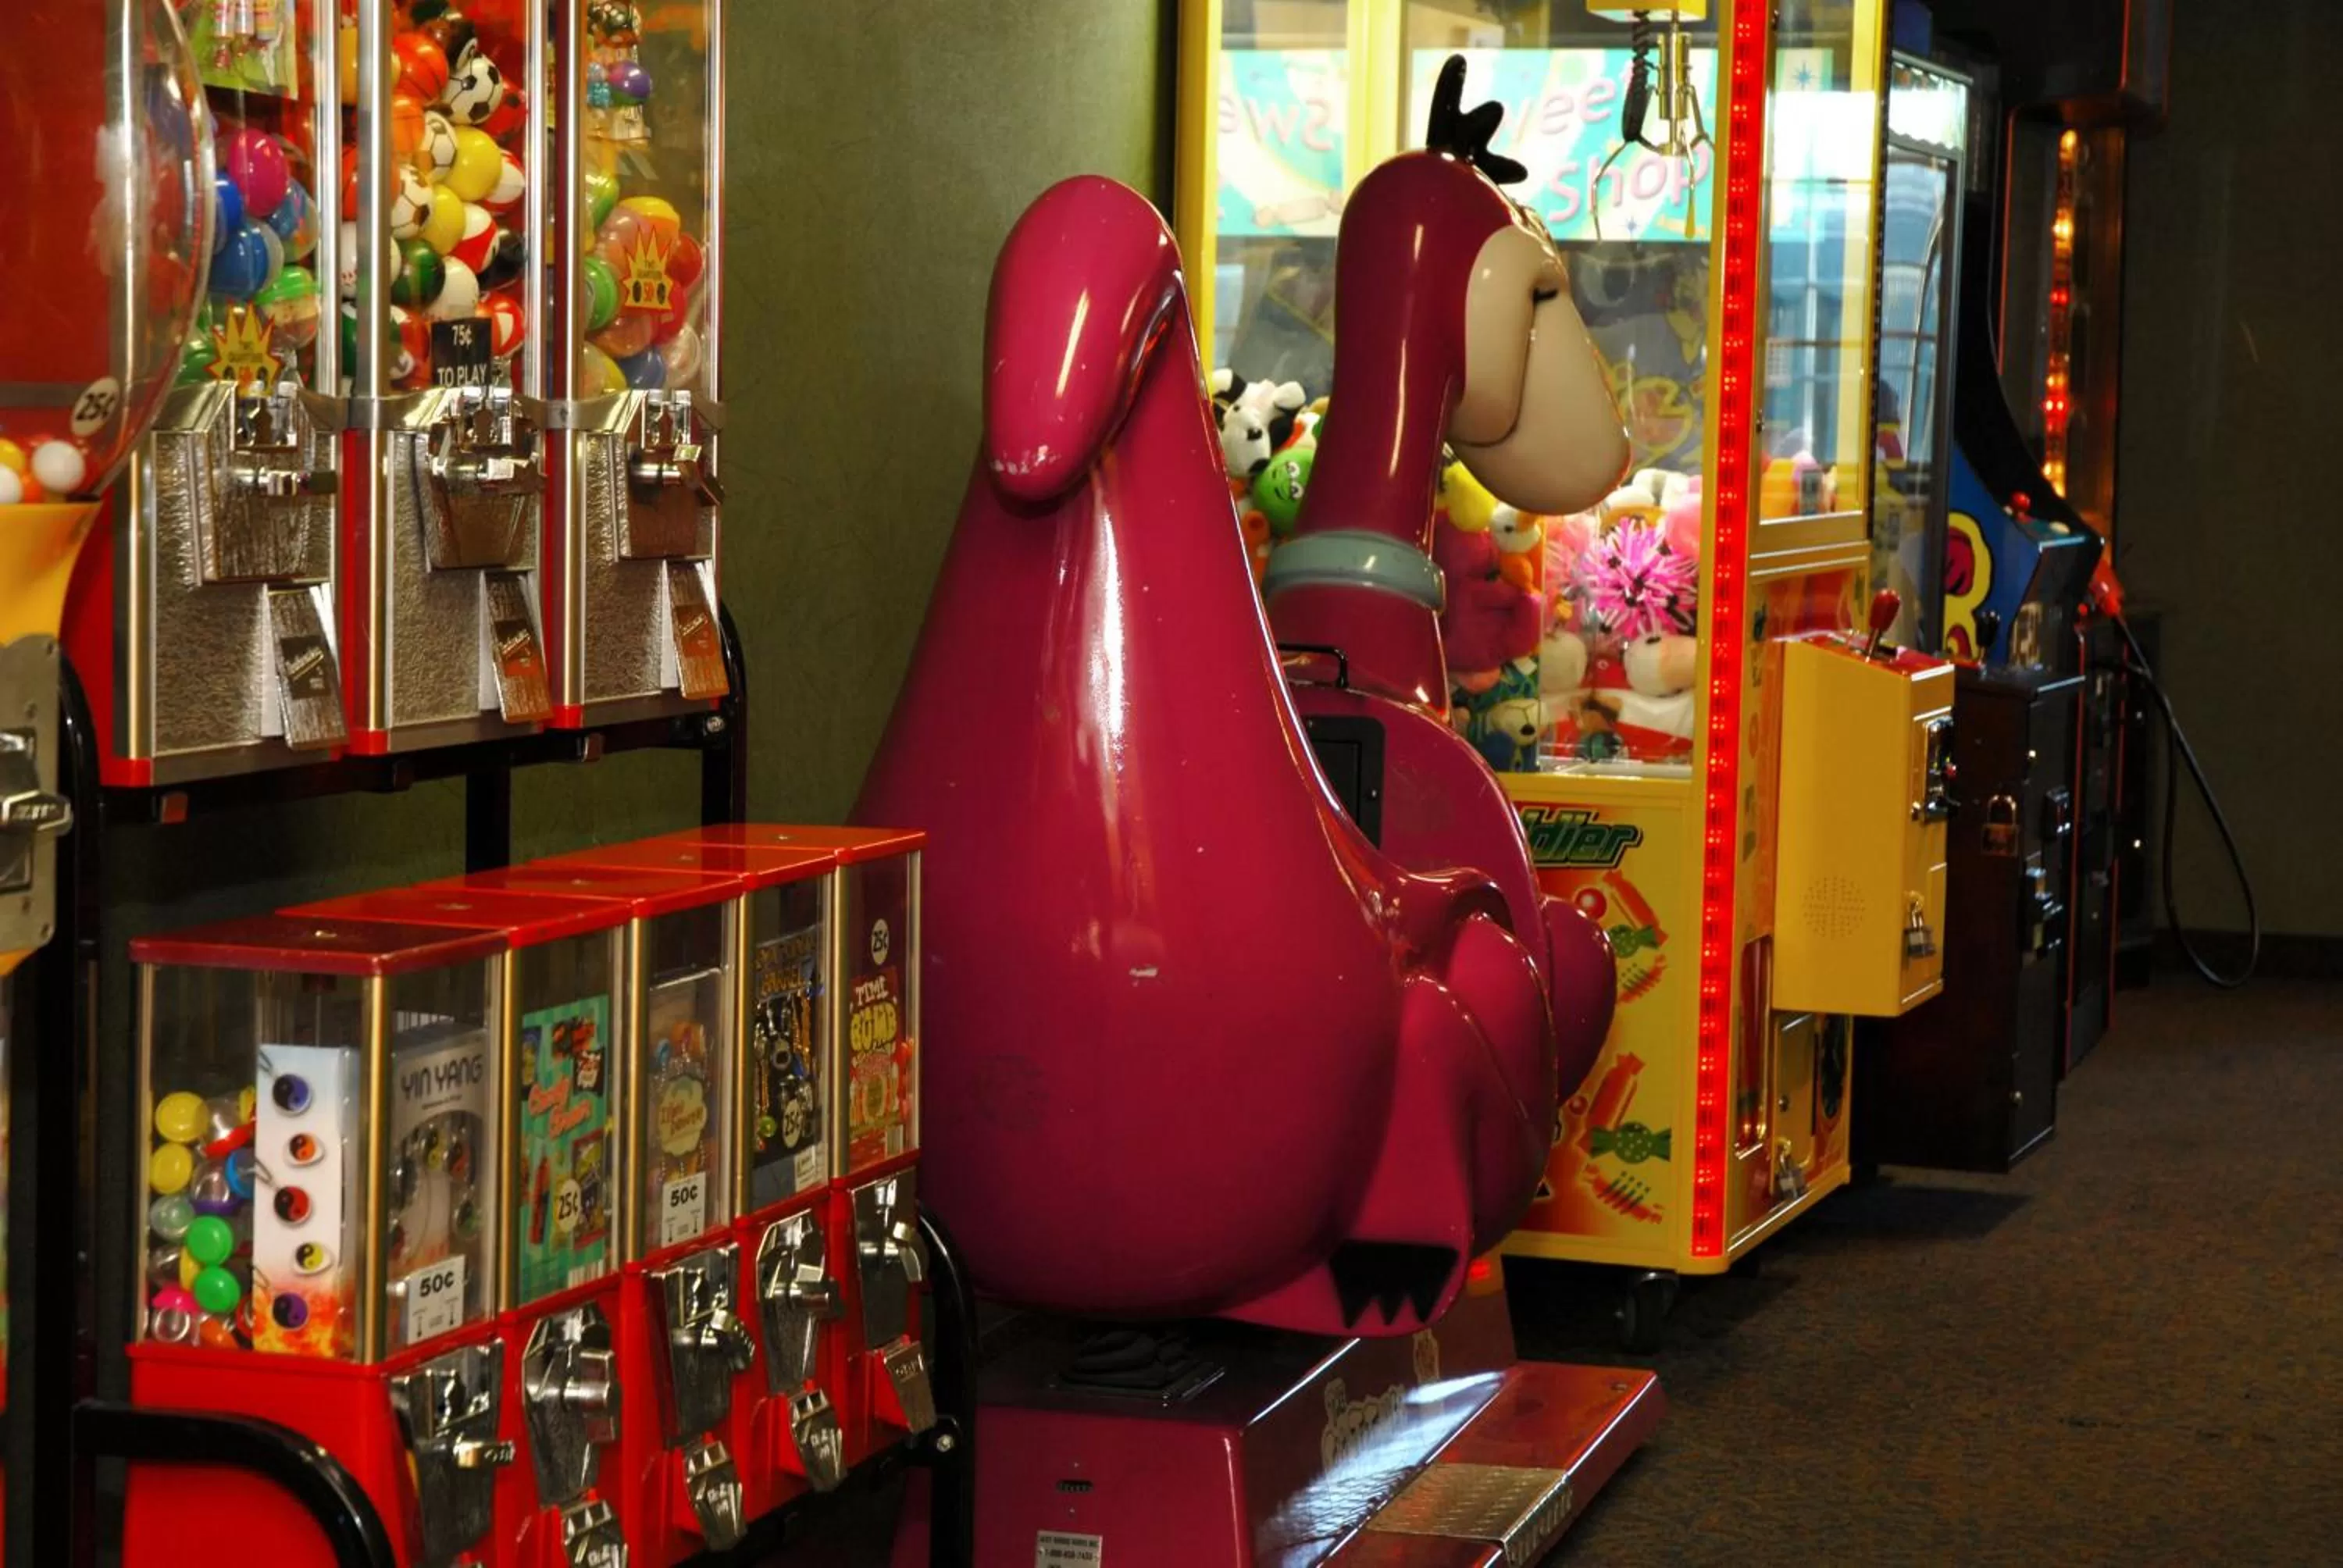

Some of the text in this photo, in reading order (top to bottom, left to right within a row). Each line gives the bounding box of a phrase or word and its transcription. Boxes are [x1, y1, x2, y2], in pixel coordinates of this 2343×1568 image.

[451, 323, 473, 351] 75¢
[437, 362, 488, 388] TO PLAY
[76, 392, 116, 421] 25¢
[854, 976, 890, 1007] TIME
[400, 1066, 432, 1102] YIN
[434, 1053, 483, 1092] YANG
